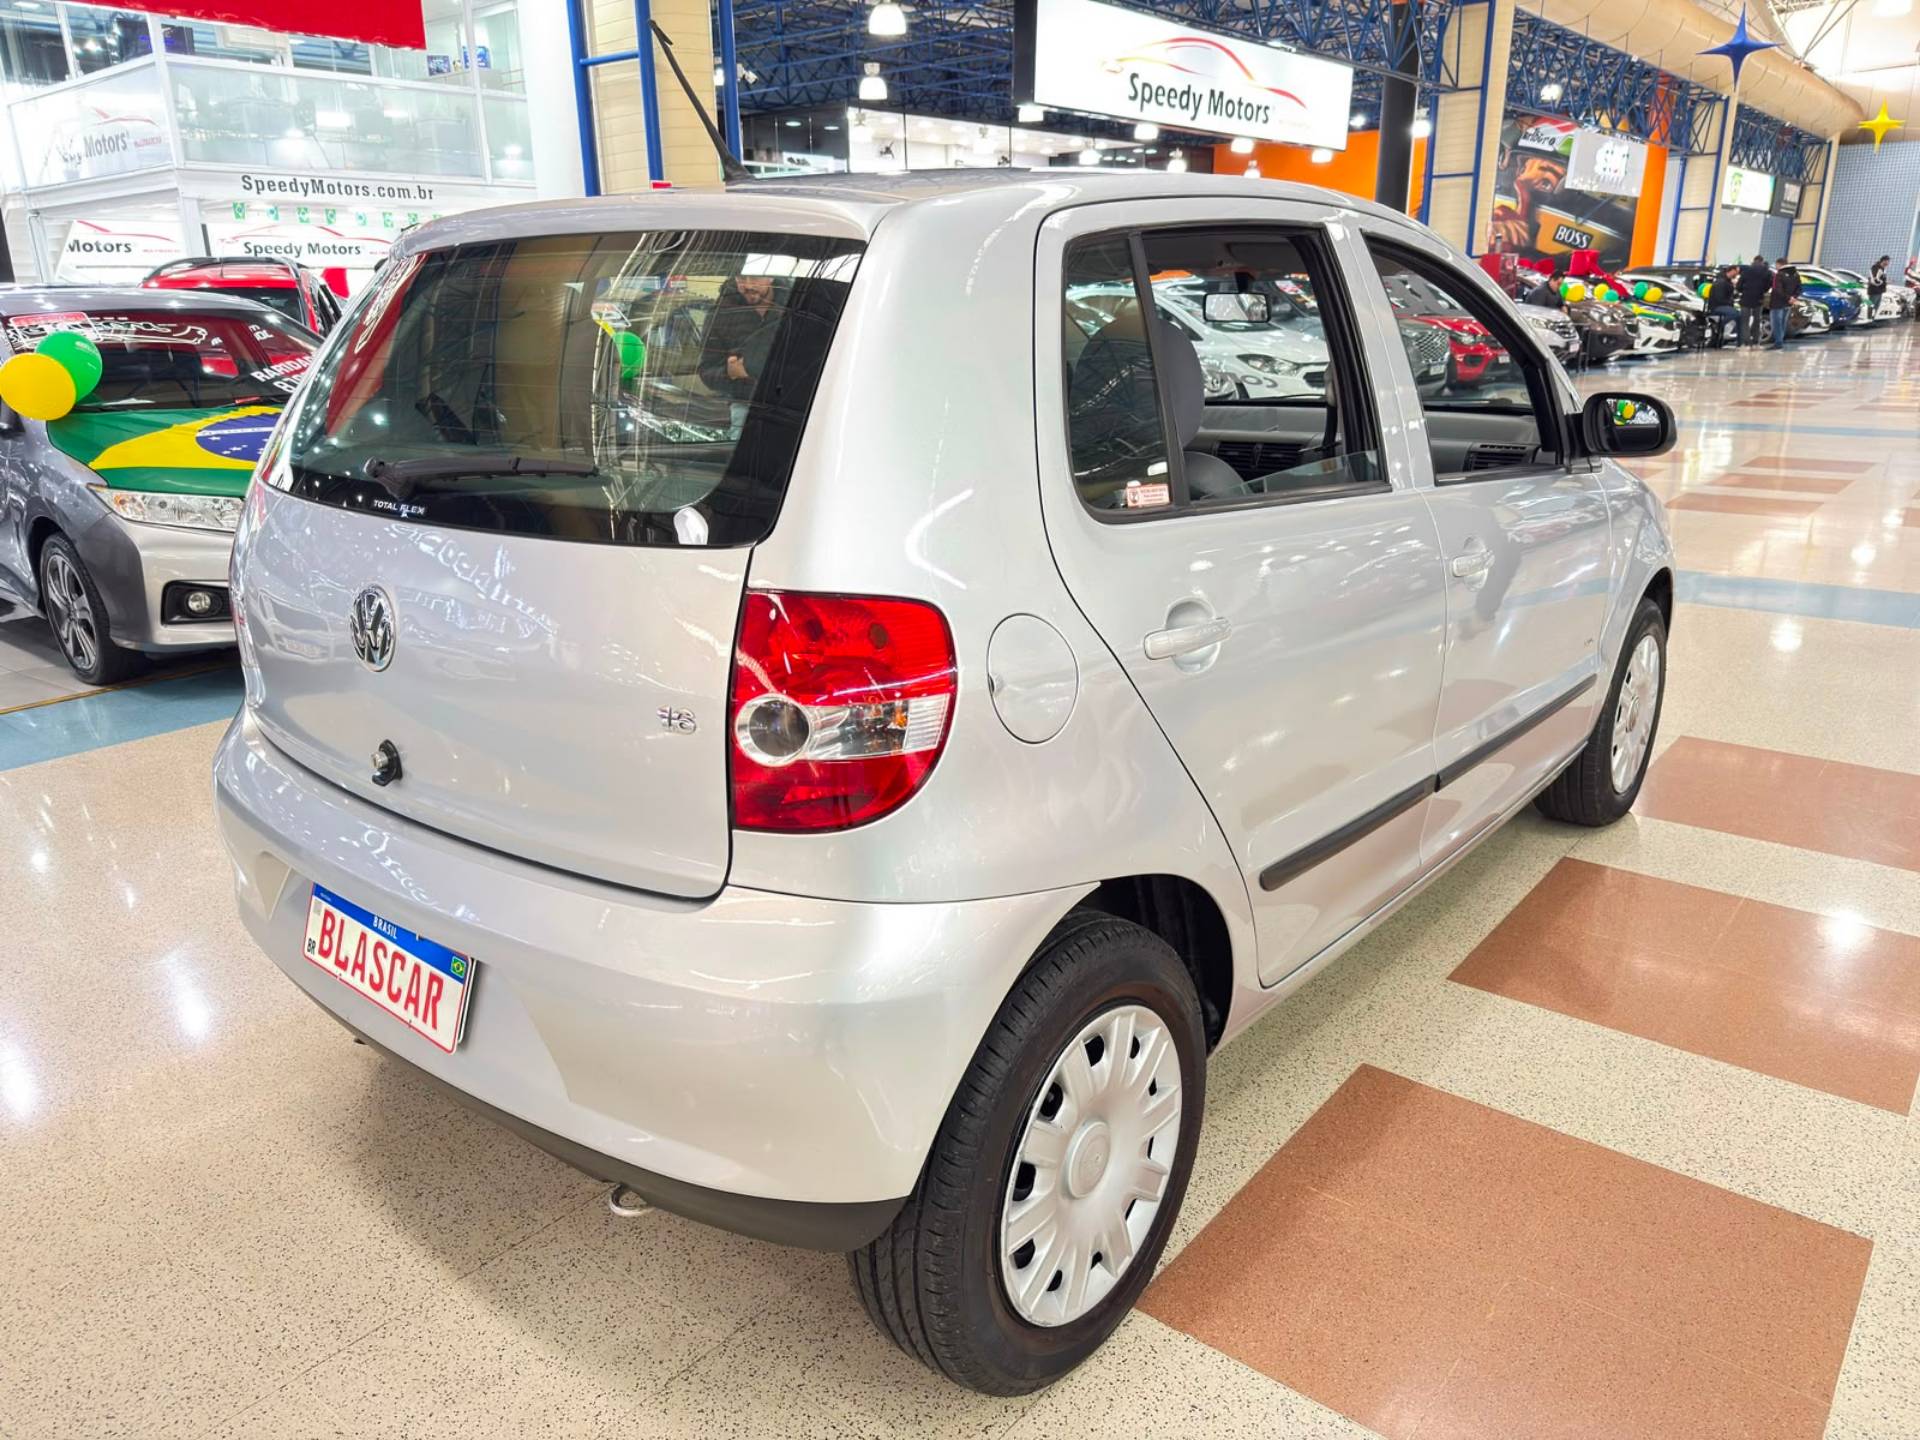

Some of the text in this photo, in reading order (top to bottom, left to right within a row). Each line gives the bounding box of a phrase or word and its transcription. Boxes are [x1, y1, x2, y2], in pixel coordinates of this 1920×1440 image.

[1127, 72, 1270, 124] Speedy Motors
[241, 174, 434, 200] SpeedyMotors.com.br
[243, 241, 302, 257] Speedy
[307, 242, 361, 255] Motors
[1555, 226, 1591, 249] BOSS
[374, 499, 425, 515] TOTAL FLEX
[373, 914, 398, 939] BRASIL
[306, 937, 316, 956] BR
[318, 908, 444, 1030] BLASCAR
